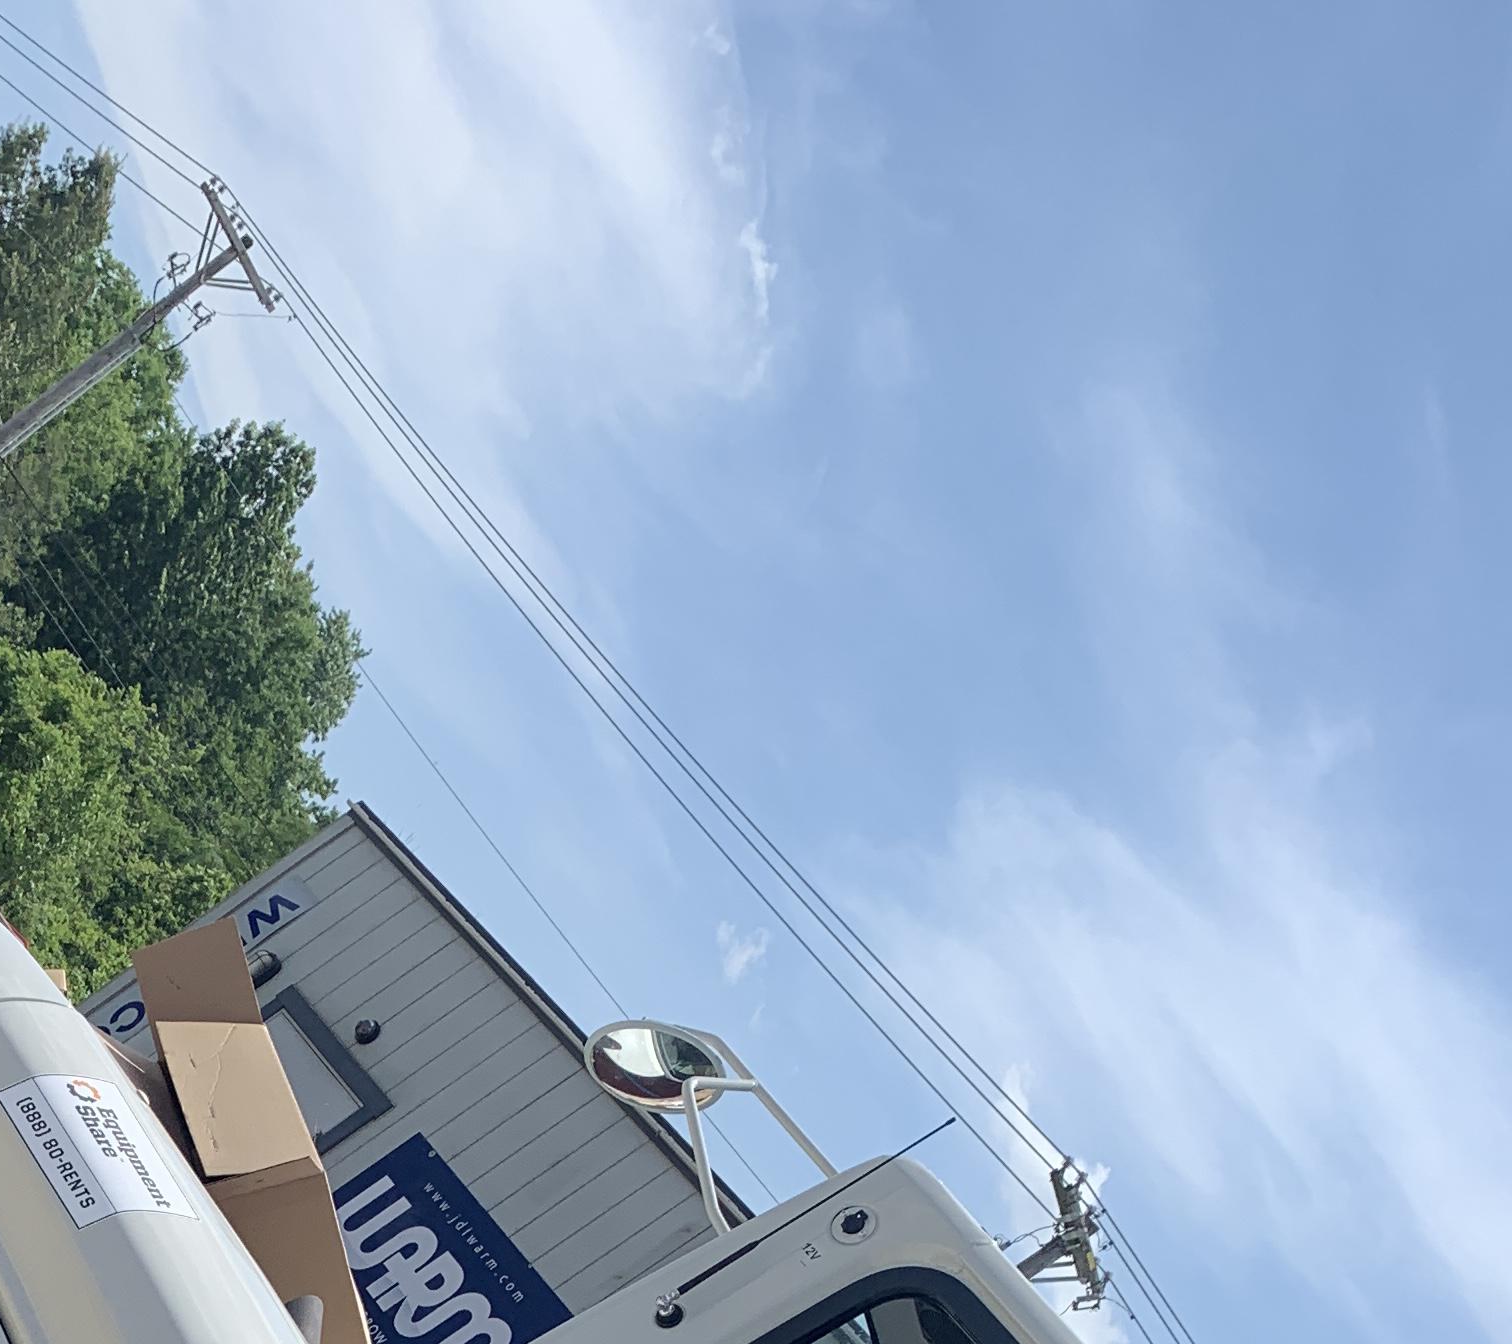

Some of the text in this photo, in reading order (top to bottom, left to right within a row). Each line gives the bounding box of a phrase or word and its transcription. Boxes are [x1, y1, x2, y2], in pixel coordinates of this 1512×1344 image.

[16, 1096, 96, 1209] (888) 80-RENTS
[75, 1104, 119, 1158] Share
[97, 1106, 171, 1208] Equipment
[423, 1181, 524, 1303] www.jdlwarm.com
